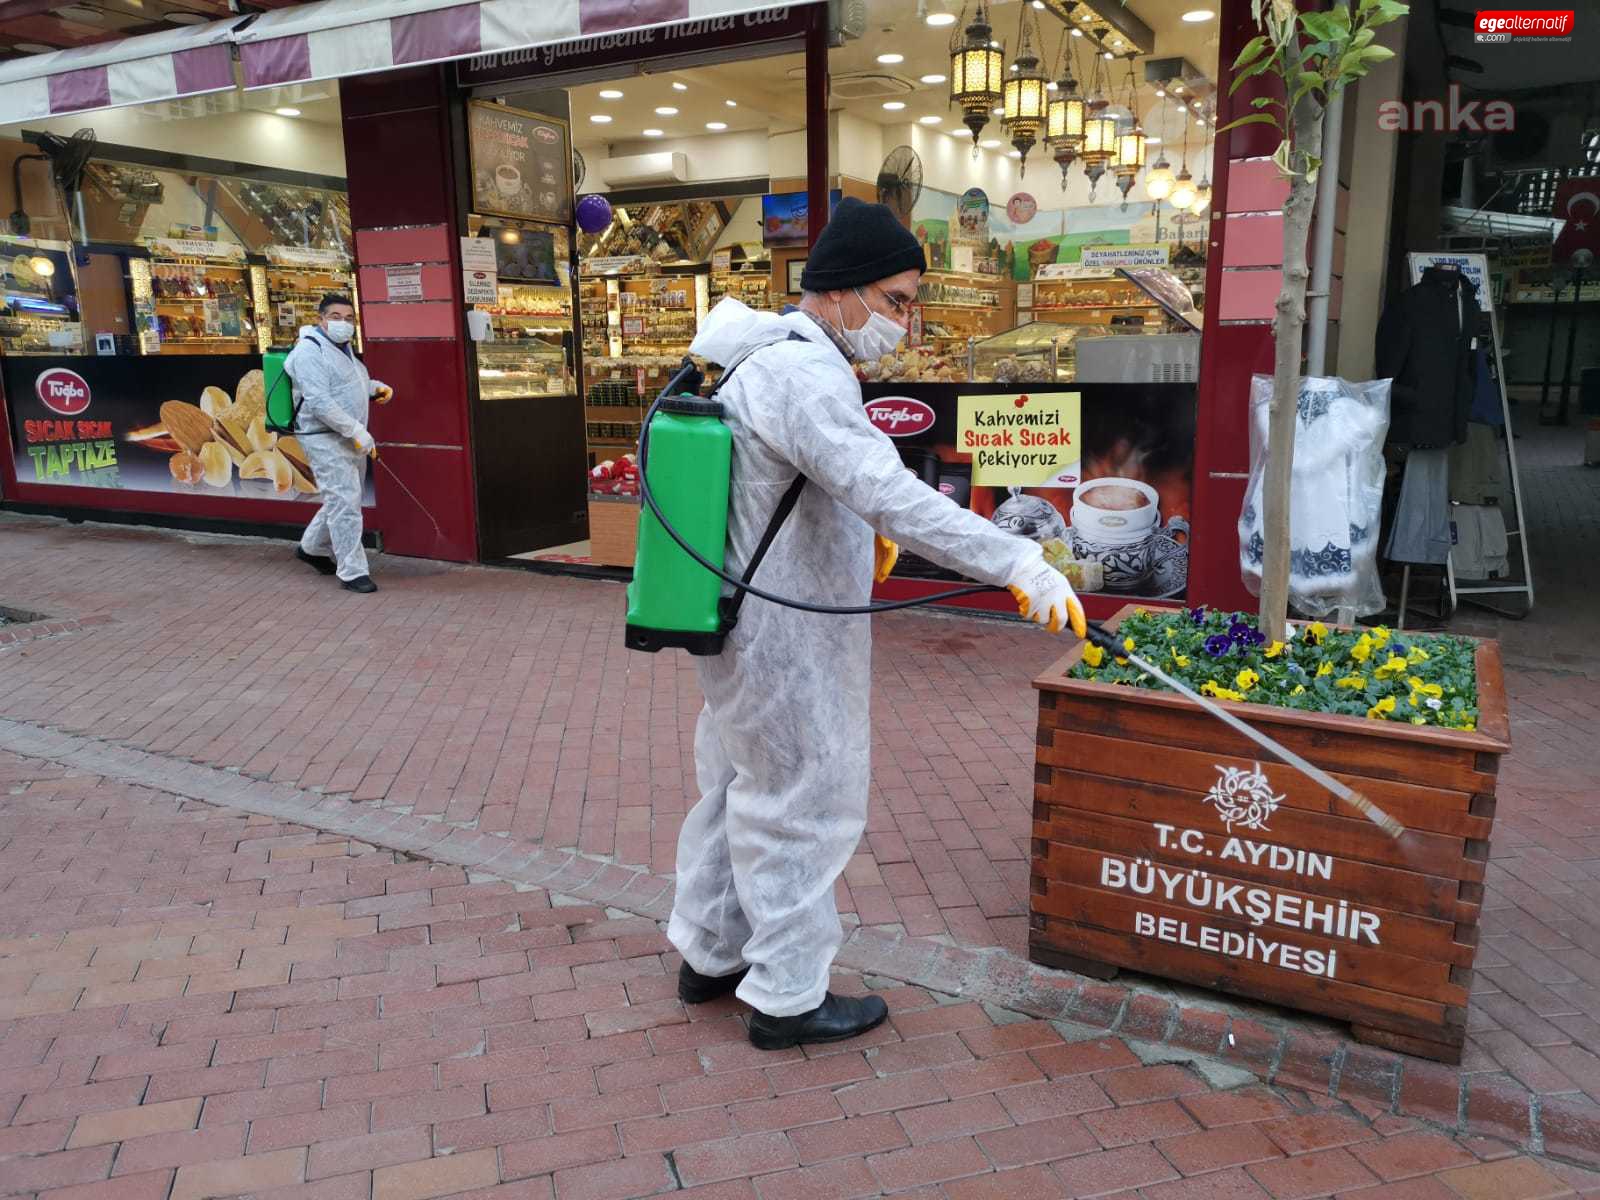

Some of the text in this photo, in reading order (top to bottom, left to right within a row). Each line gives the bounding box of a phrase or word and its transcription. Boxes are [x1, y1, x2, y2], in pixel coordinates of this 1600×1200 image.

[964, 428, 1071, 447] Sıcak Sıcak
[974, 409, 1060, 427] Kahvemizi
[27, 439, 118, 480] TAPTAZE
[978, 450, 1057, 468] Çekiyoruz
[1153, 823, 1333, 880] T.C. AYDIN
[1100, 857, 1381, 945] BÜYÜKŞEHİR
[1135, 911, 1337, 979] BELEDİYESİ
